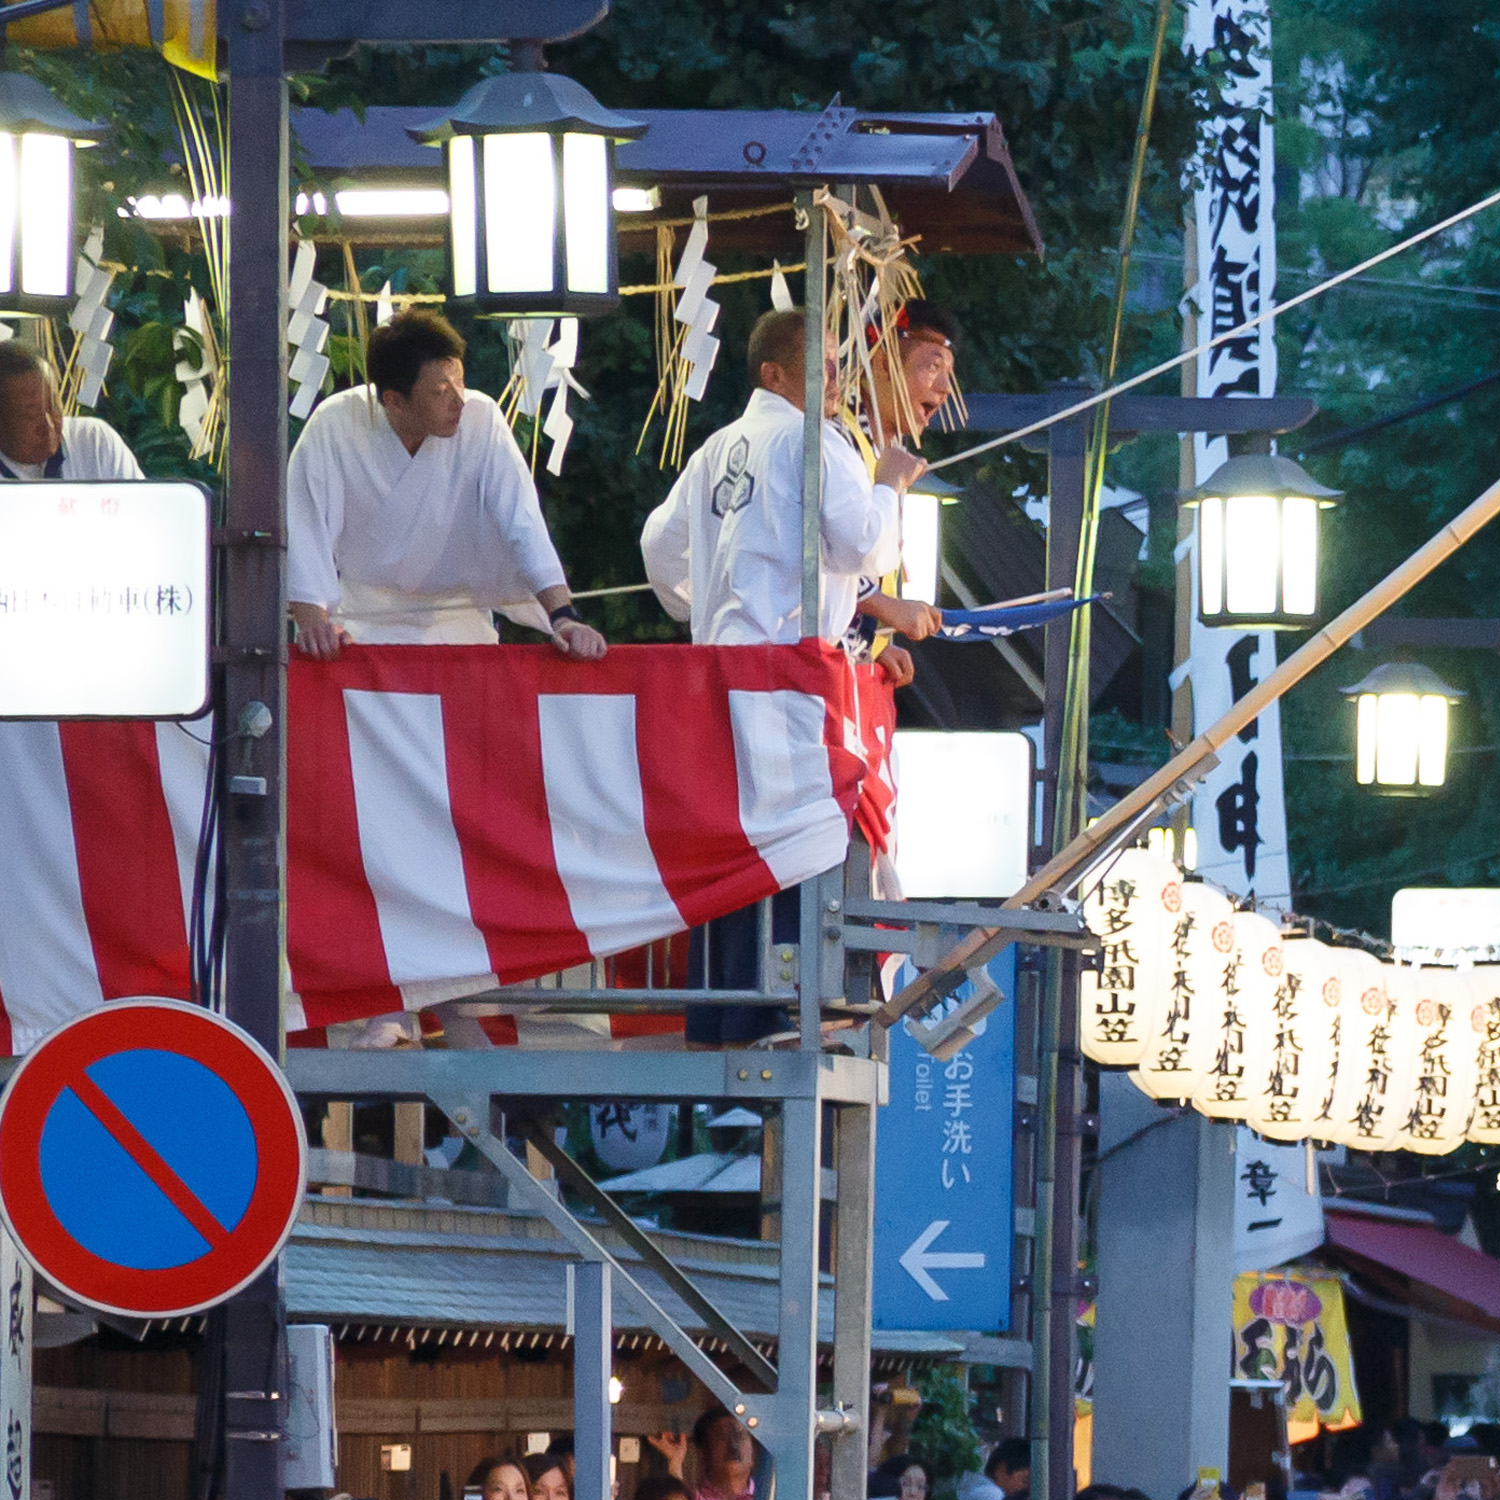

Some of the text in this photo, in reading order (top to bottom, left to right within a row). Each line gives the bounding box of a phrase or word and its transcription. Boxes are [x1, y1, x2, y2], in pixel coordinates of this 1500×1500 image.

[1094, 879, 1140, 1043] 博多祇園山笠
[942, 1050, 974, 1189] お手洗い
